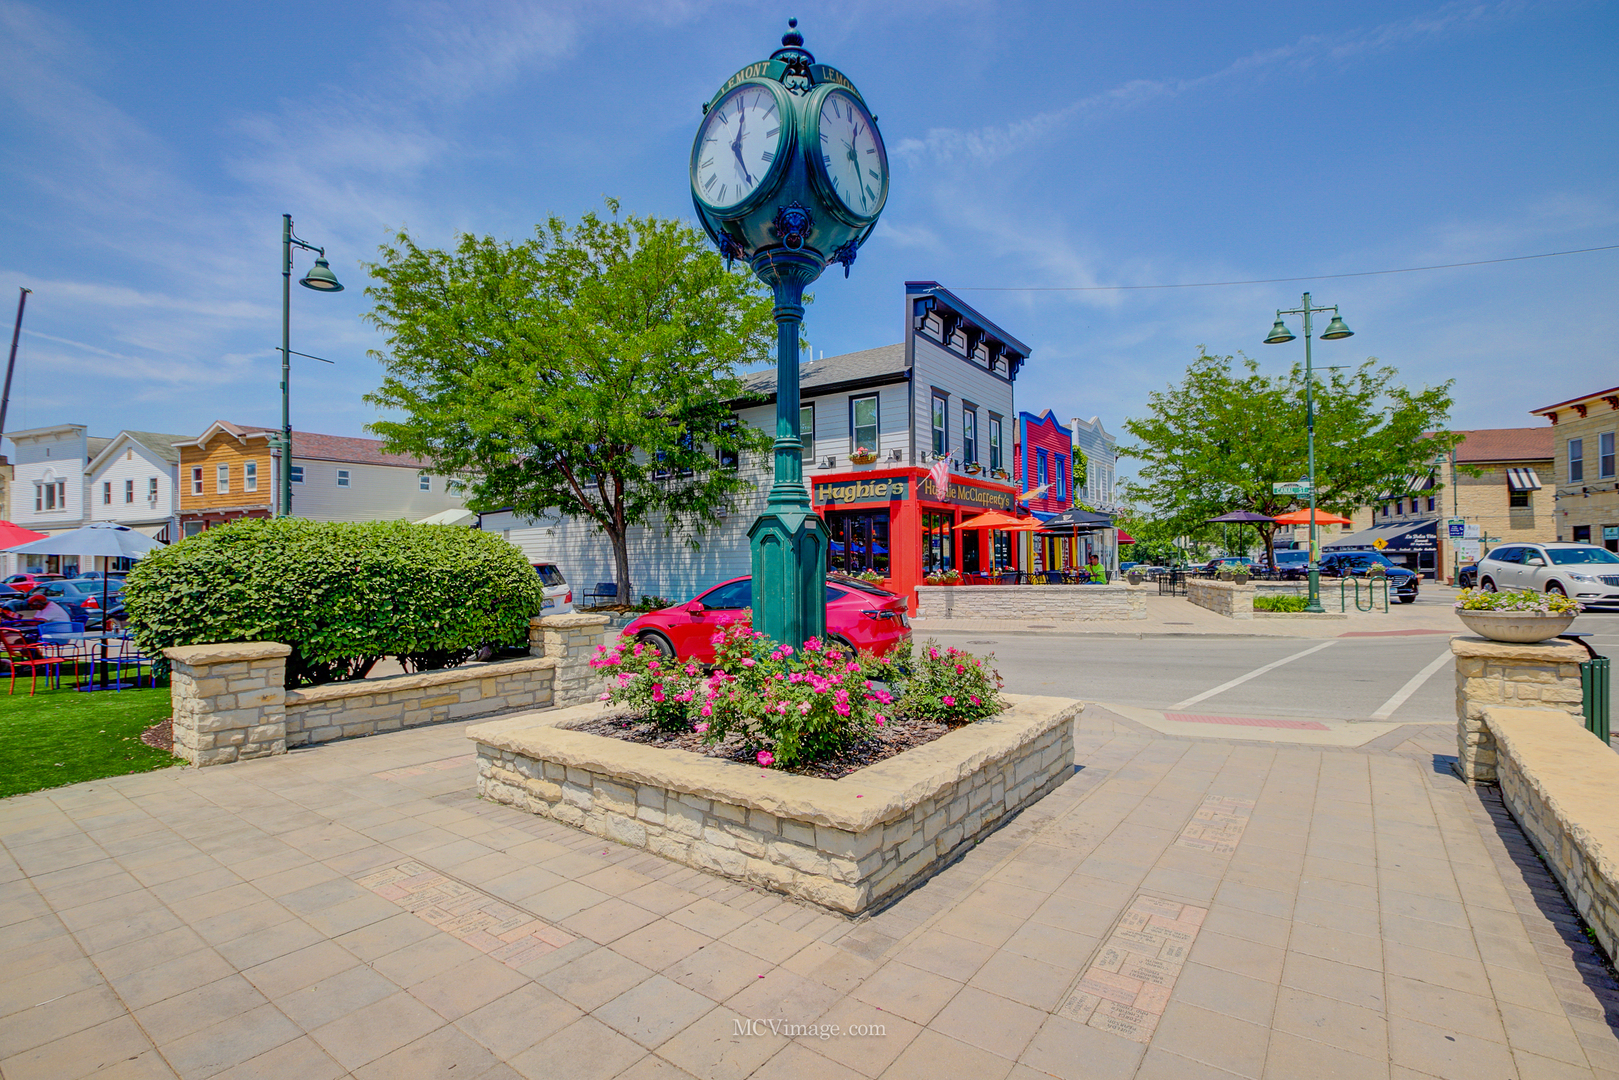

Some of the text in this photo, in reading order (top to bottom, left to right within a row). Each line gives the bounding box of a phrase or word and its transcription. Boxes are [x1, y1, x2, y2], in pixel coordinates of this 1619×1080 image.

[721, 62, 771, 93] LEMONT
[822, 67, 862, 98] LEMON
[818, 478, 904, 503] Hughie's
[924, 481, 1010, 510] Huie McClafferty's
